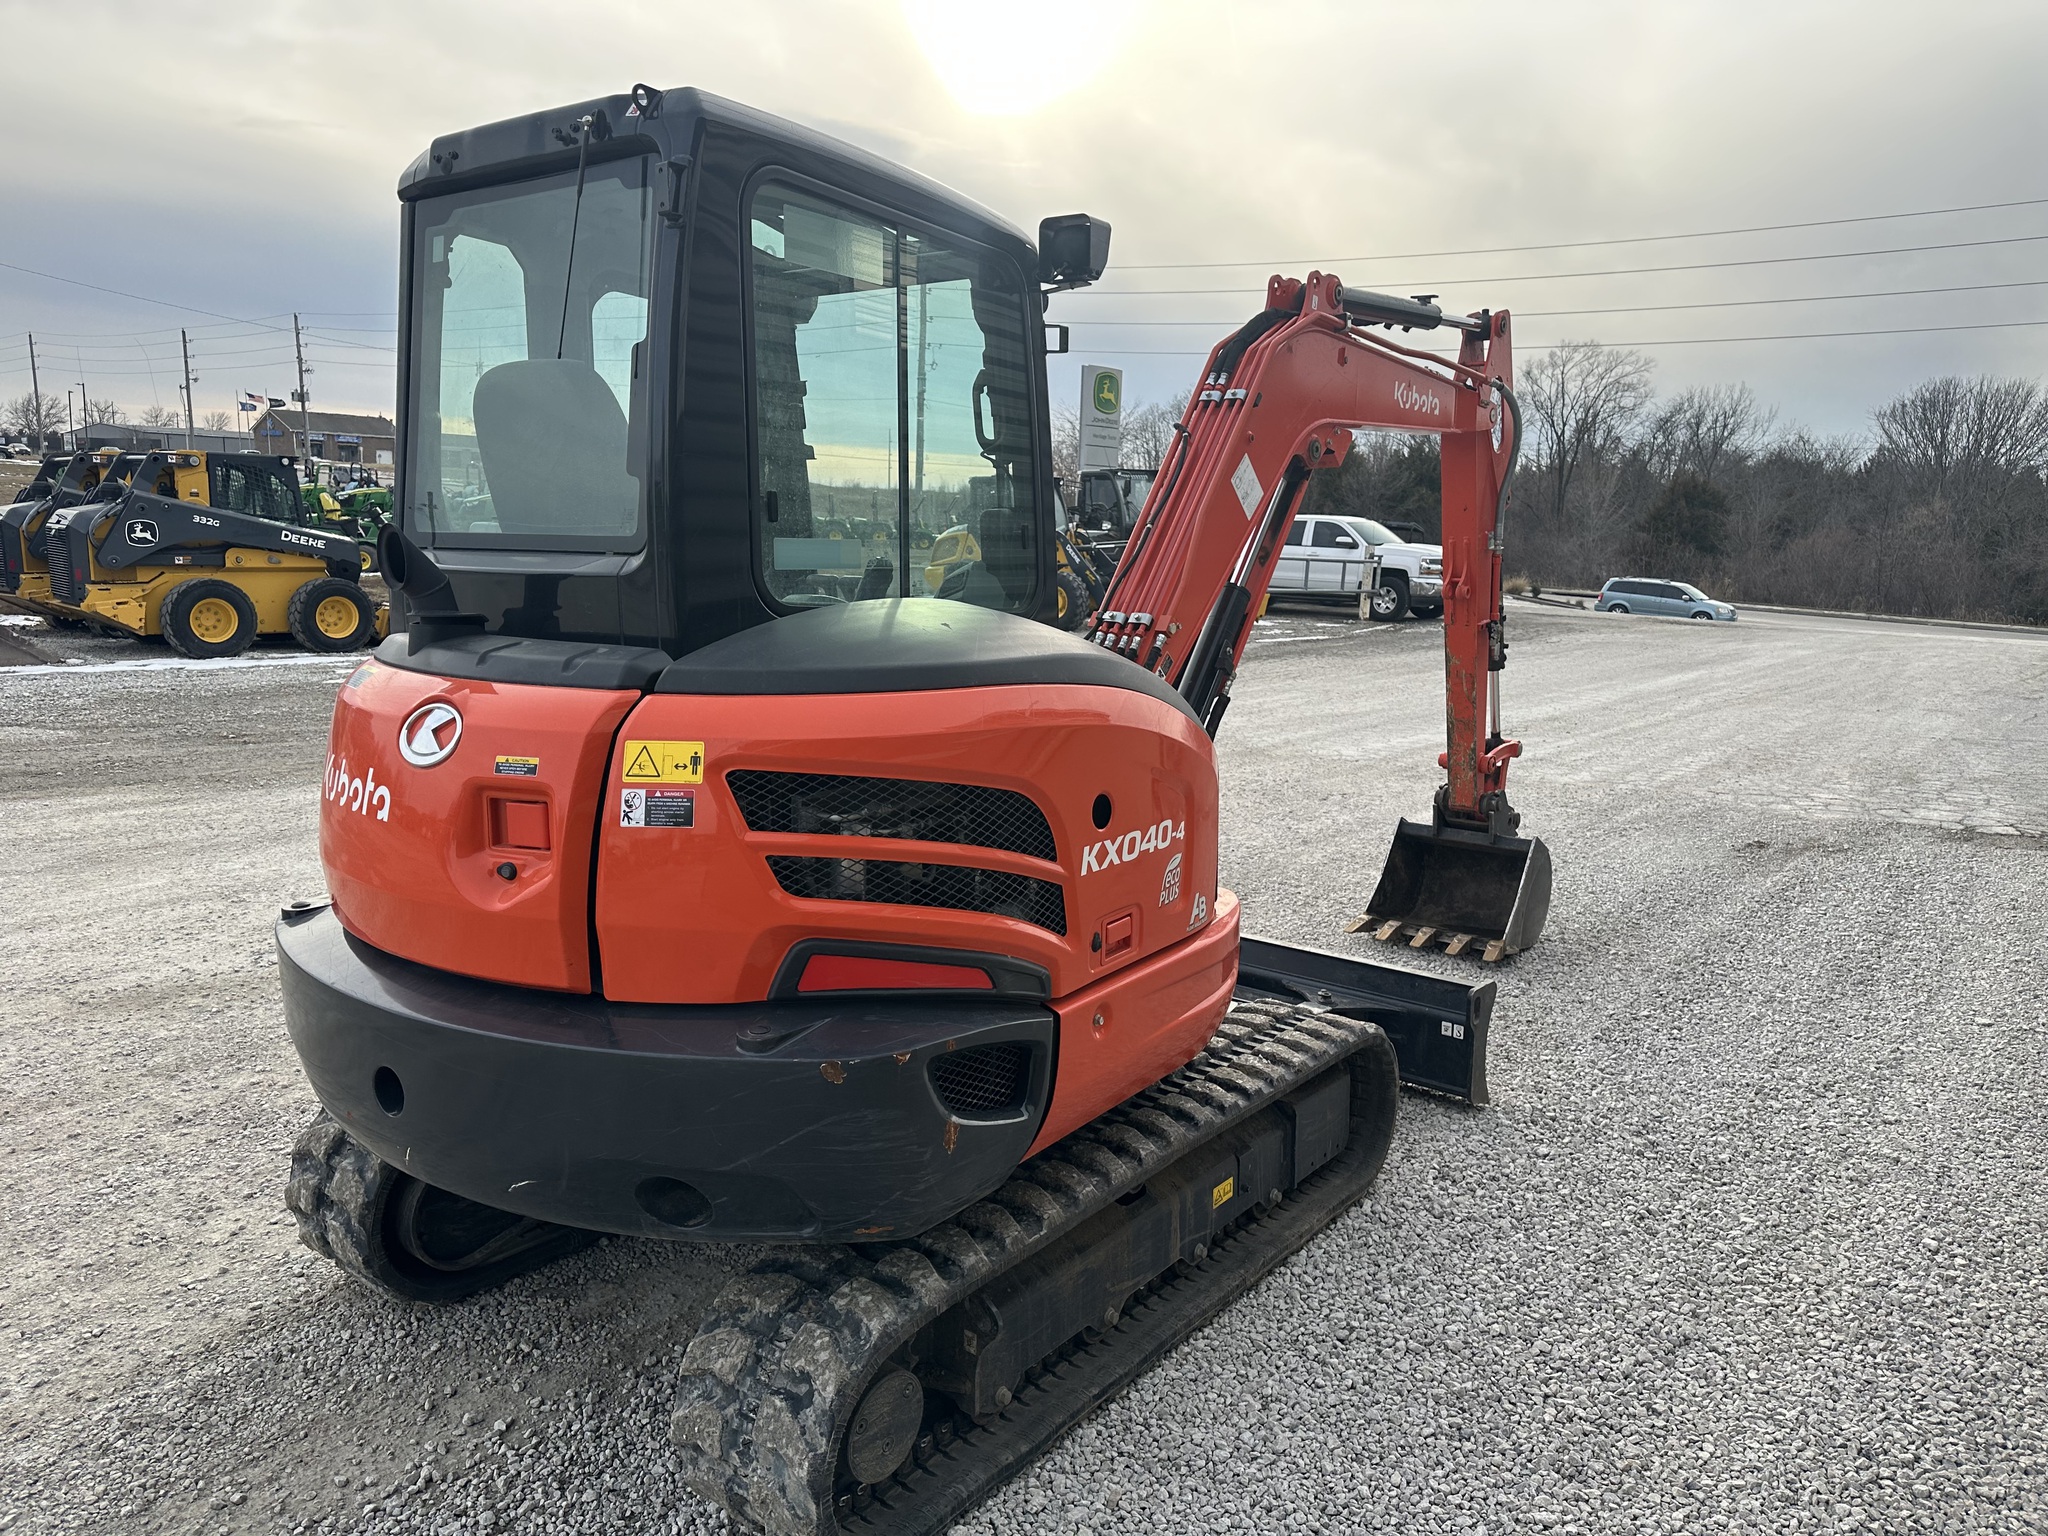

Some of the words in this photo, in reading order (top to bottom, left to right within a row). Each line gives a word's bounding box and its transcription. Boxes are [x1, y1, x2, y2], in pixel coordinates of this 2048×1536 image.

[1394, 380, 1440, 416] Kubota
[192, 515, 220, 527] 332G
[281, 530, 326, 549] DEERE
[1065, 543, 1081, 565] DEERE
[1080, 819, 1185, 877] KX040-4
[1165, 867, 1181, 888] eco
[1158, 882, 1180, 908] PLUS
